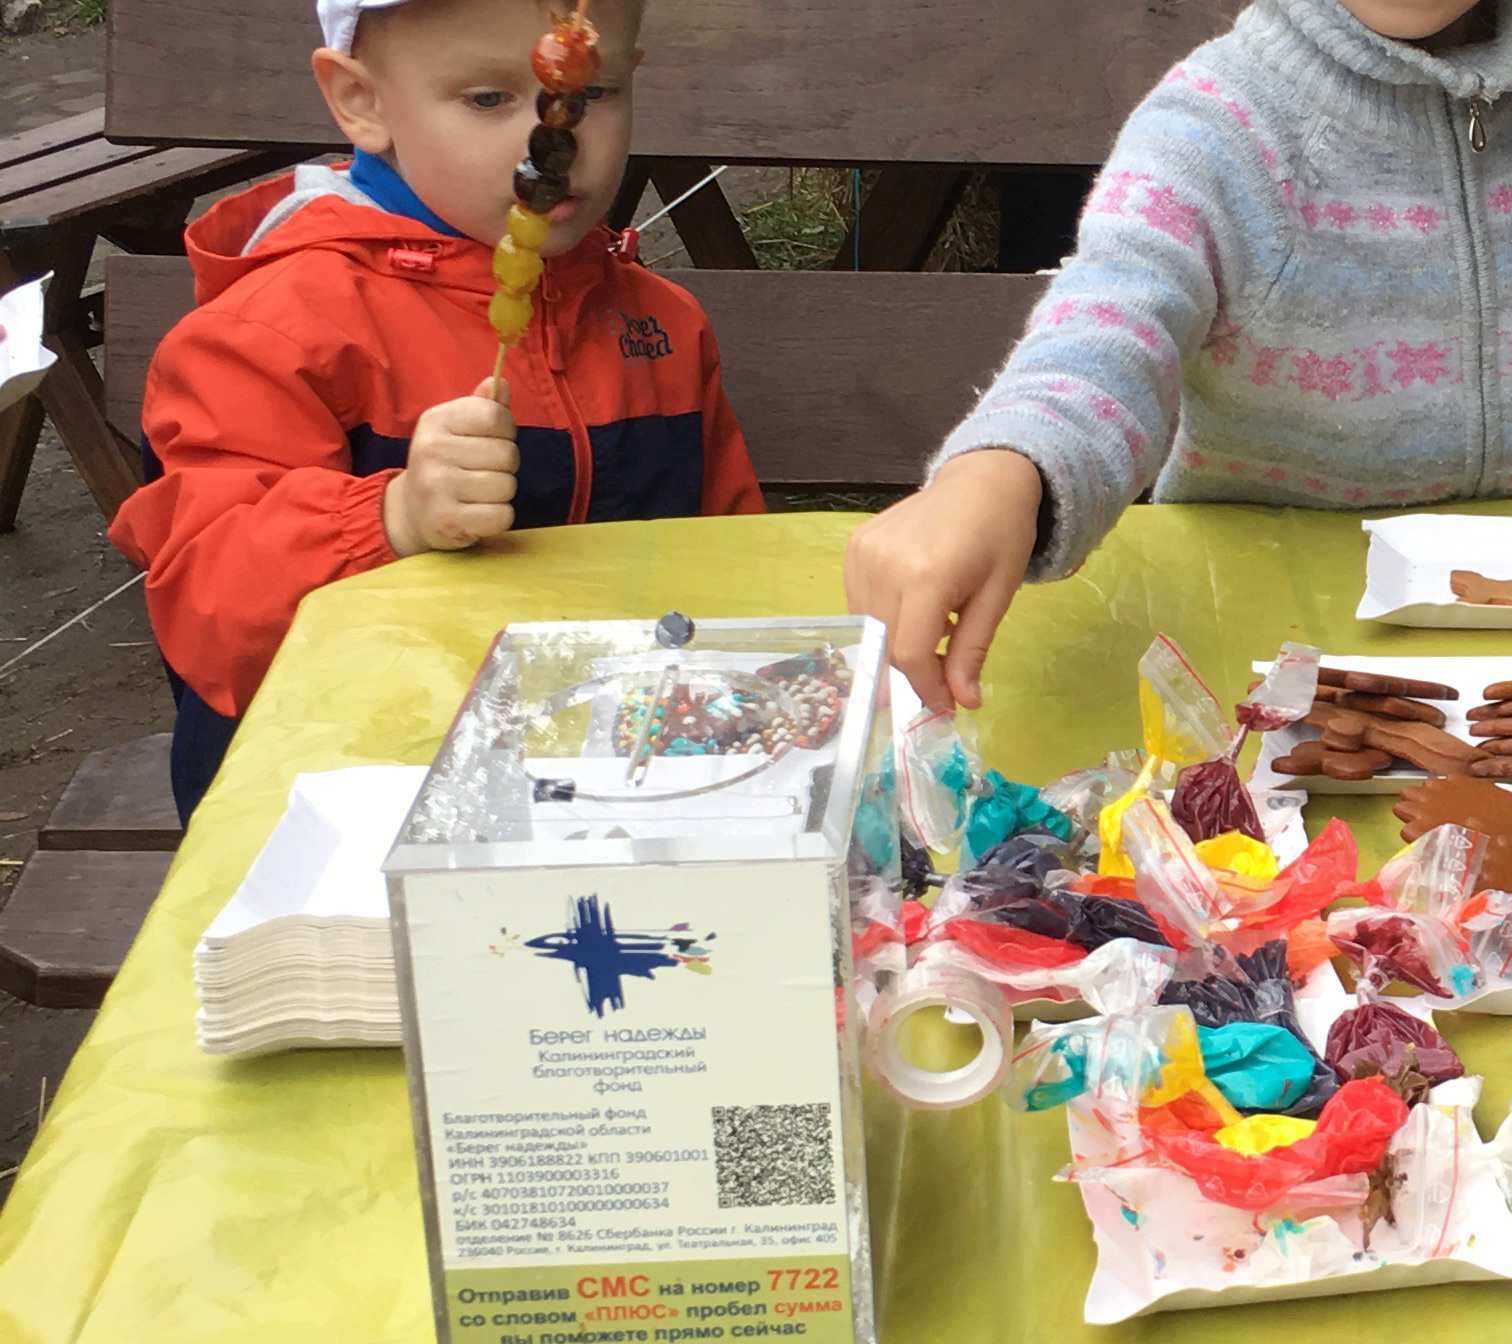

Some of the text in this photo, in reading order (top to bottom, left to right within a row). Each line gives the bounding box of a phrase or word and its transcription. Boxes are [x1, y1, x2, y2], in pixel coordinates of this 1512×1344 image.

[538, 1046, 696, 1064] Калининградский
[532, 1061, 707, 1079] благотворительный
[593, 1078, 643, 1096] фонд
[443, 1106, 647, 1125] Благотворительный фонд
[445, 1123, 651, 1141] Калининградской области
[448, 1156, 484, 1169] ИНН
[588, 1151, 620, 1165] КПП
[626, 1149, 709, 1164] 390601001
[450, 1172, 492, 1186] ОГРН
[452, 1188, 477, 1203] р/с
[455, 1219, 487, 1232] БИК
[597, 1227, 673, 1241] Сбербанка
[678, 1225, 727, 1237] России
[744, 1221, 839, 1235] Калининград
[458, 1267, 839, 1305] Отправив СМС на номер 7722
[460, 1299, 843, 1327] со словом «ПЛЮС» пробел сумма
[540, 1329, 648, 1344] поможете
[655, 1325, 724, 1343] прямо
[731, 1320, 807, 1338] сейчас
